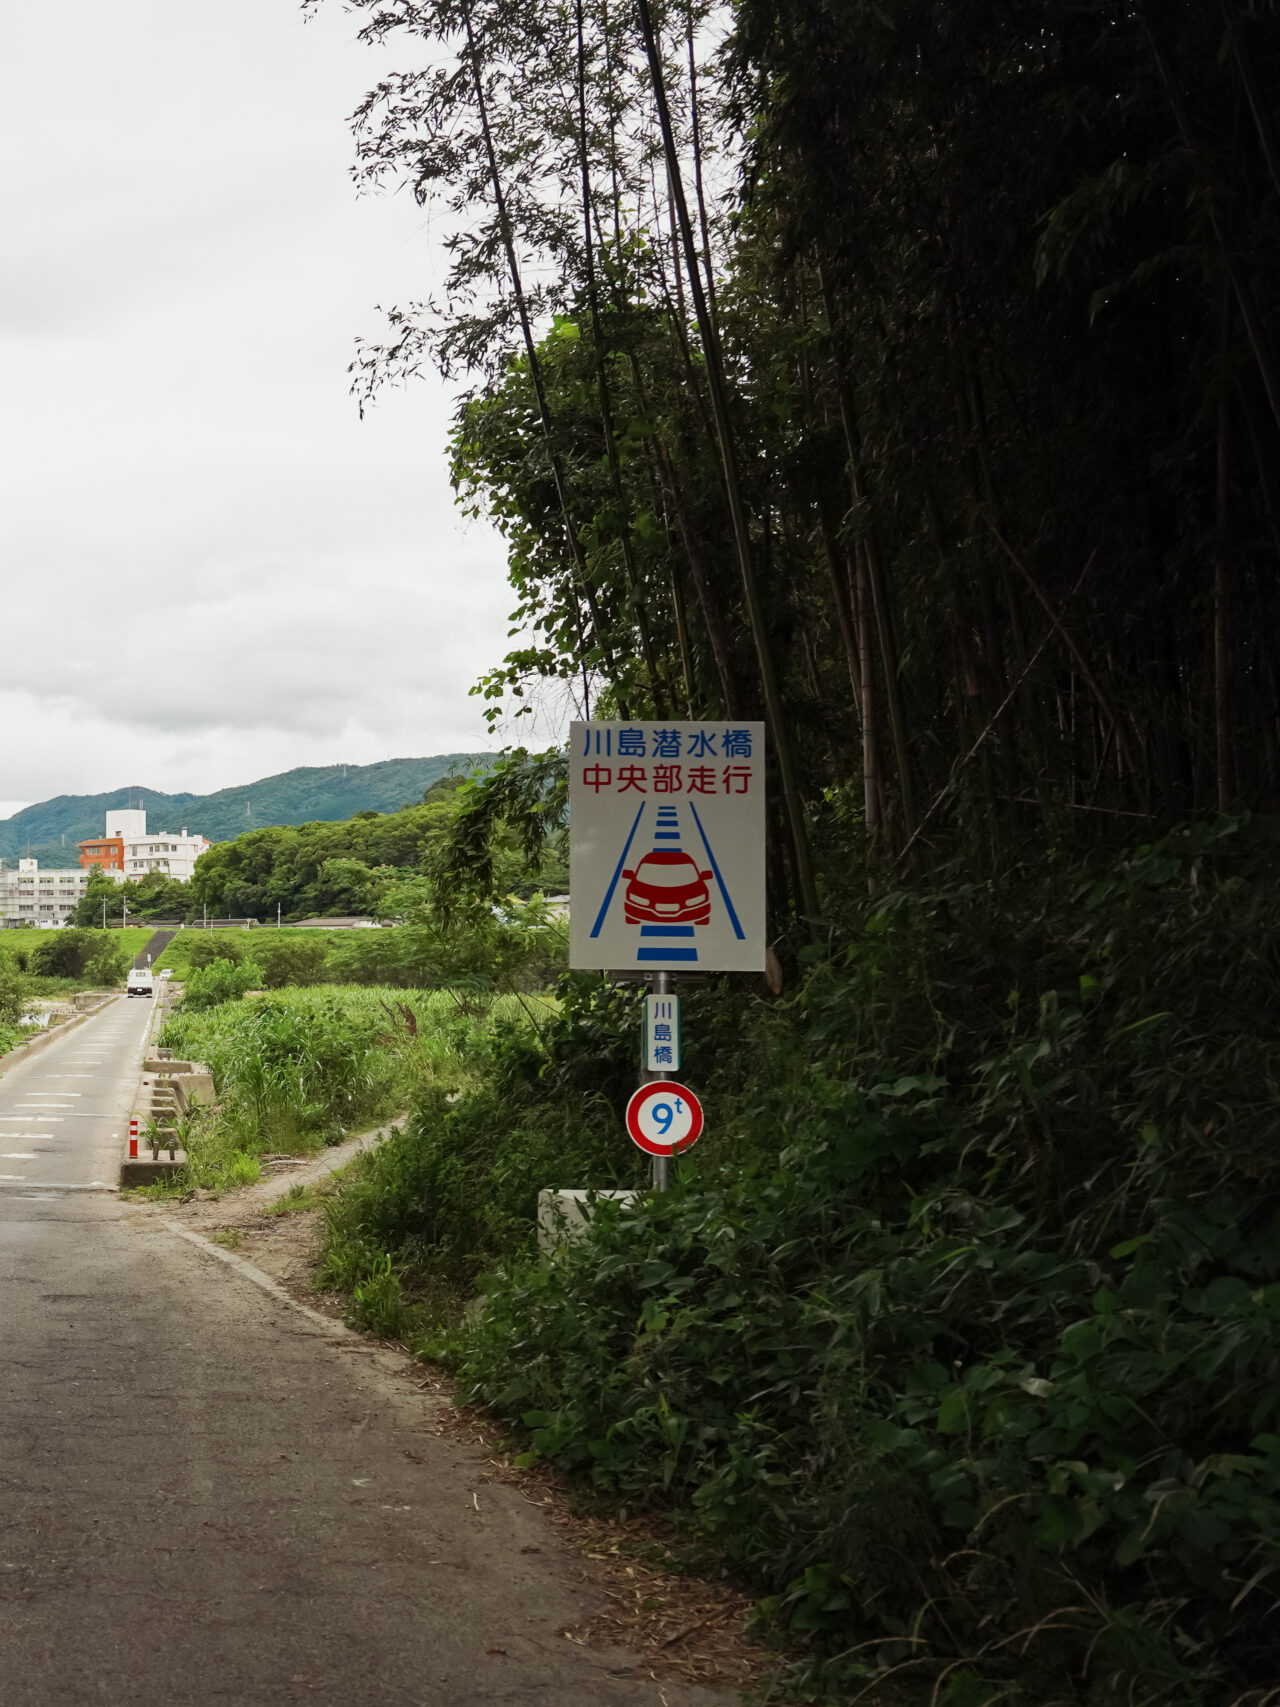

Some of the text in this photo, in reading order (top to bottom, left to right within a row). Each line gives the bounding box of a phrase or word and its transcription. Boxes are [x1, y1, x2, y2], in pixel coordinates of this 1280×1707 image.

[583, 728, 753, 758] 川島潜水橋
[583, 763, 753, 795] 中央部走行
[653, 1002, 673, 1064] 川島橋
